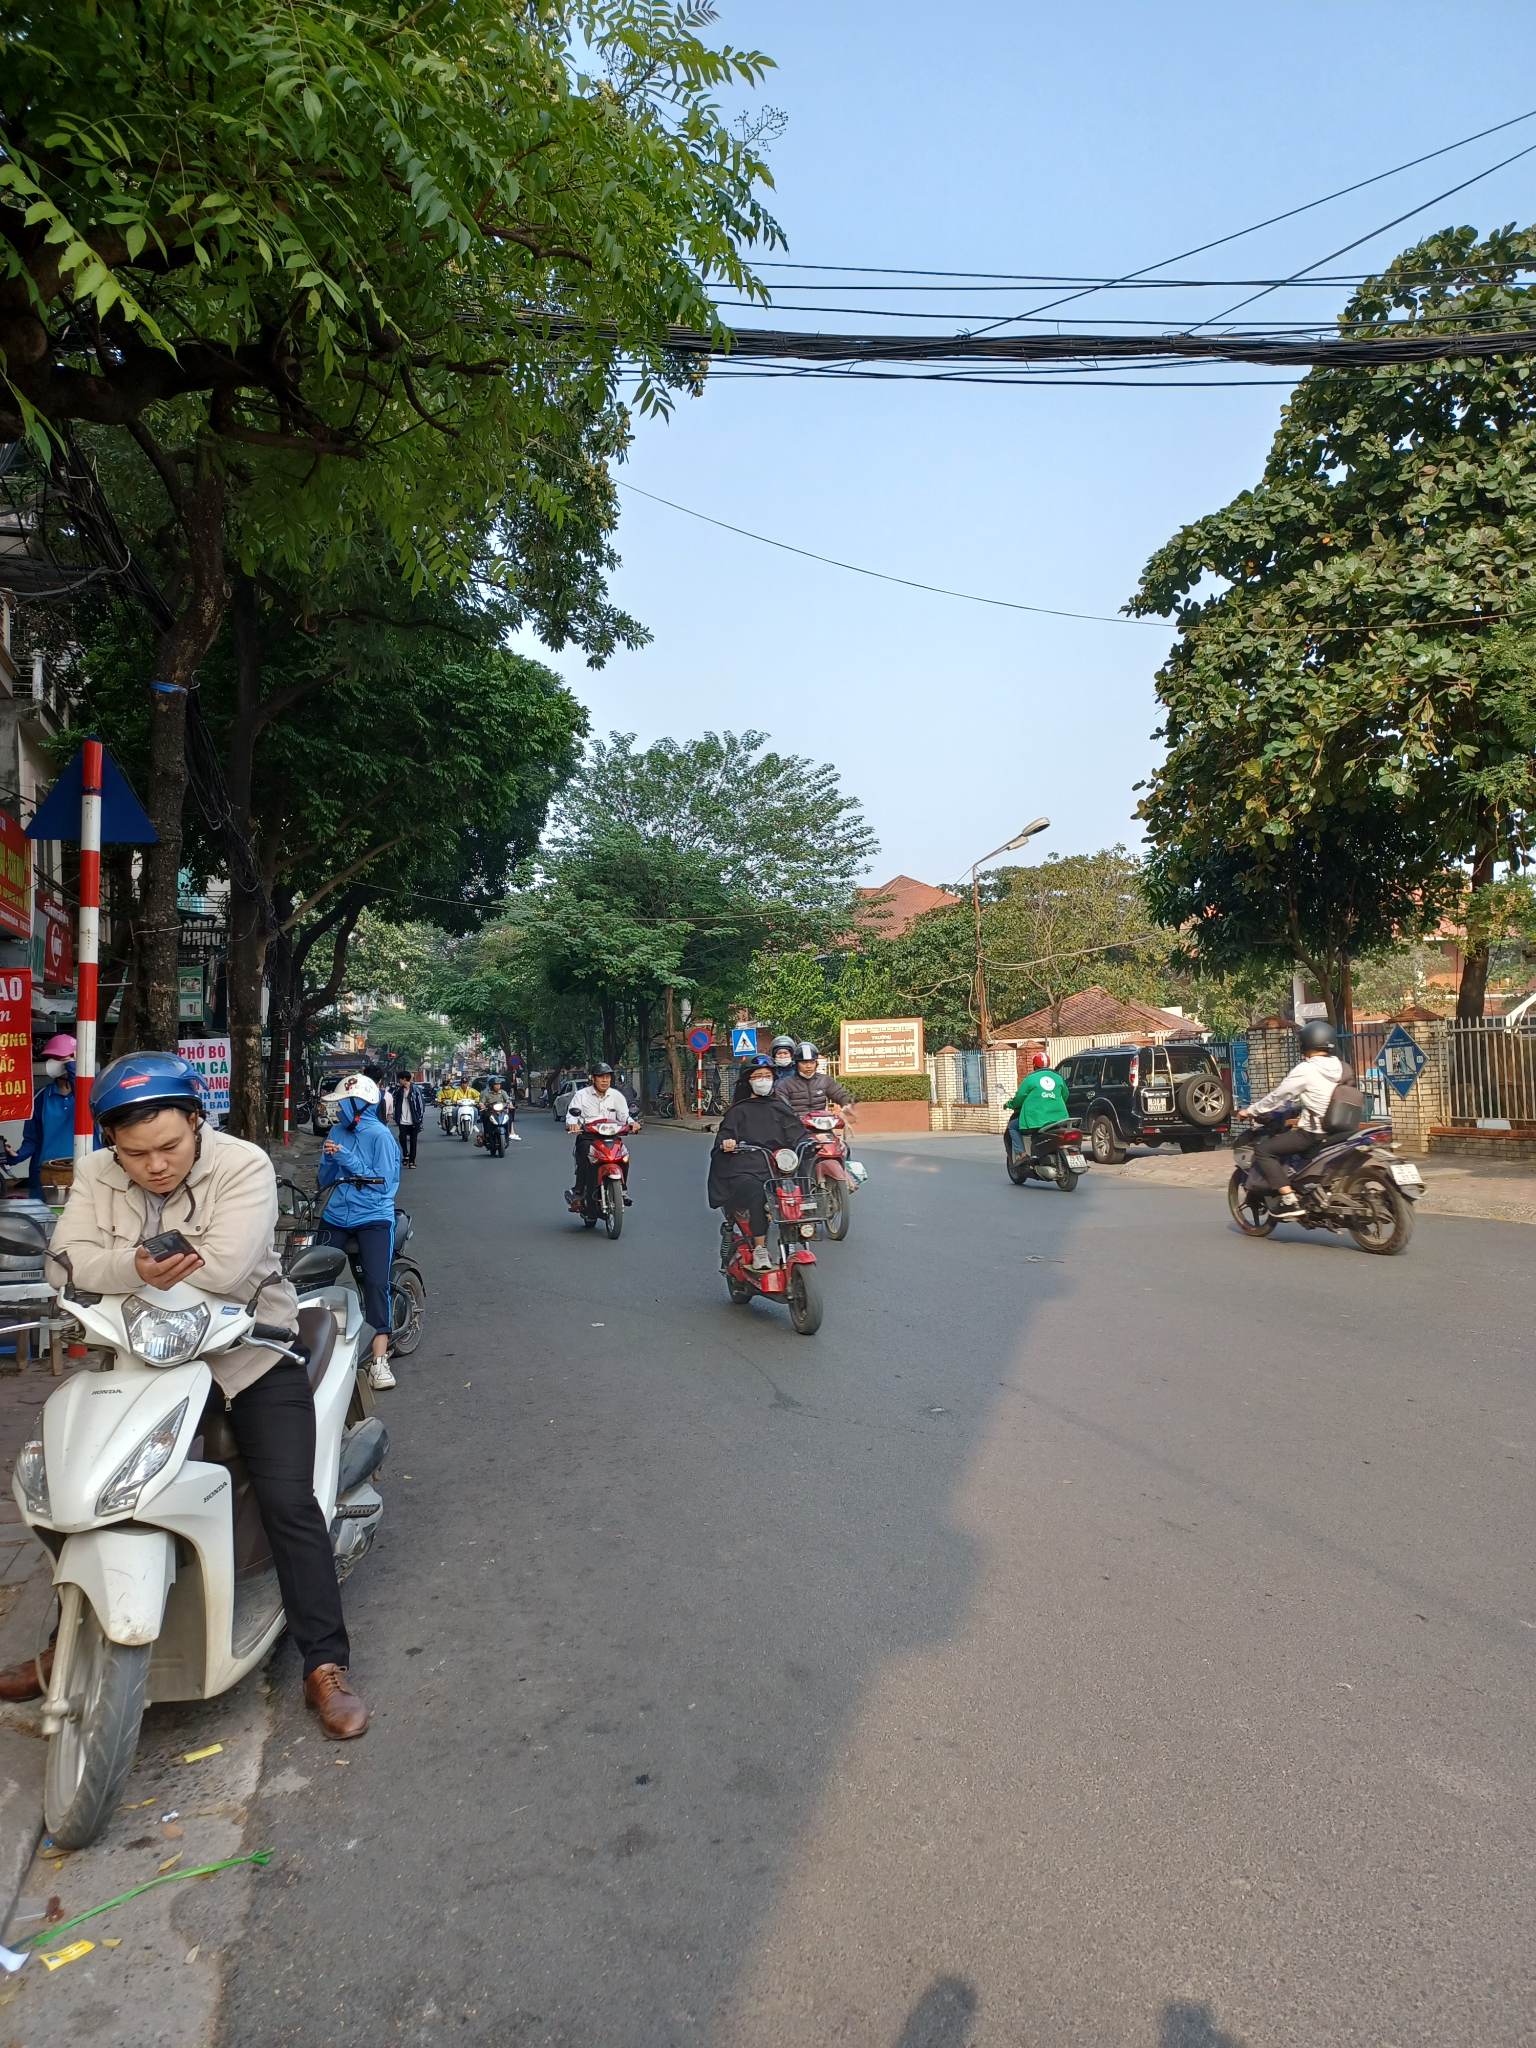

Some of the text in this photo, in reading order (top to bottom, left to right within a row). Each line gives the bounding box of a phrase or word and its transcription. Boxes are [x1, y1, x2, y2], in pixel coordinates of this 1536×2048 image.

[179, 1042, 205, 1059] PHỞ
[1041, 1091, 1056, 1099] Grab
[210, 1101, 230, 1110] BAO
[203, 1481, 227, 1503] HONDA
